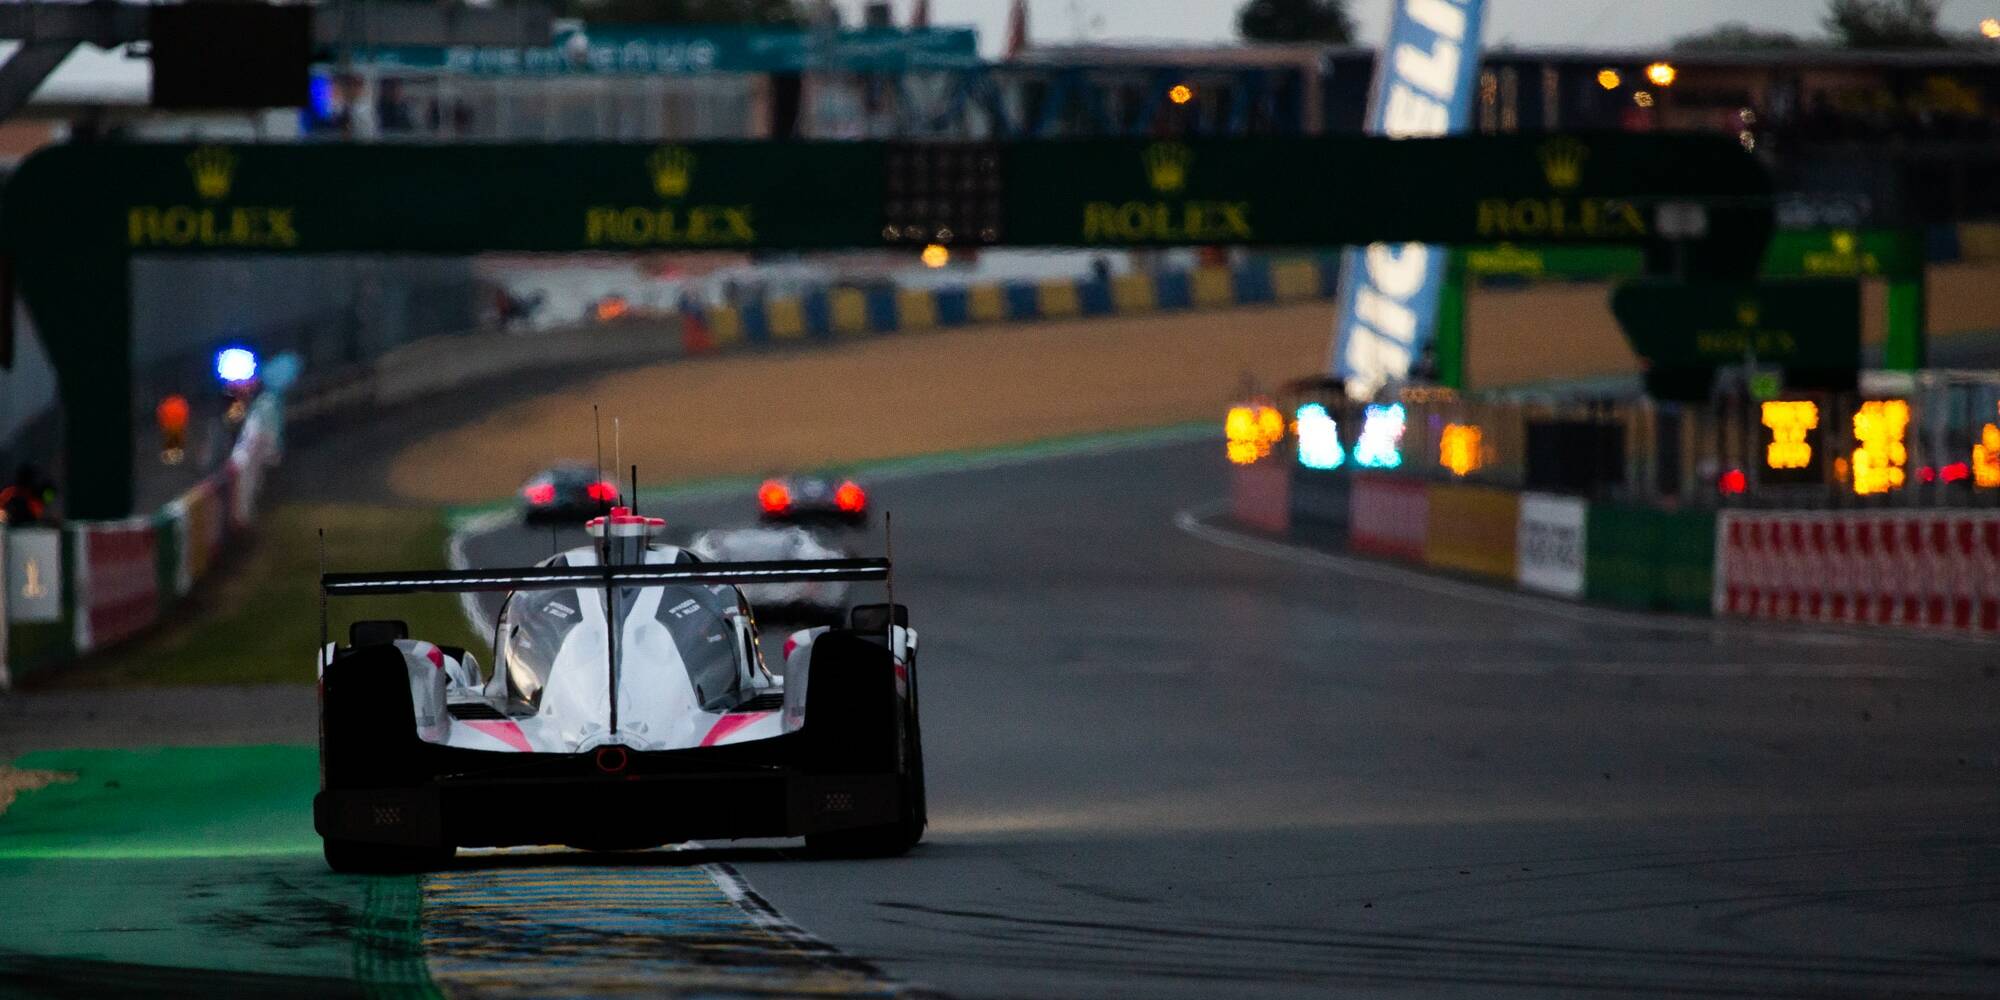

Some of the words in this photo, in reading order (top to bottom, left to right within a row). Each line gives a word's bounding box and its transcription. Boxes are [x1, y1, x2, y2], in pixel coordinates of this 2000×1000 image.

[128, 206, 298, 246] ROLEX
[584, 205, 757, 246] ROLEX
[1083, 202, 1250, 242] ROLEX
[1476, 199, 1647, 236] ROLEX
